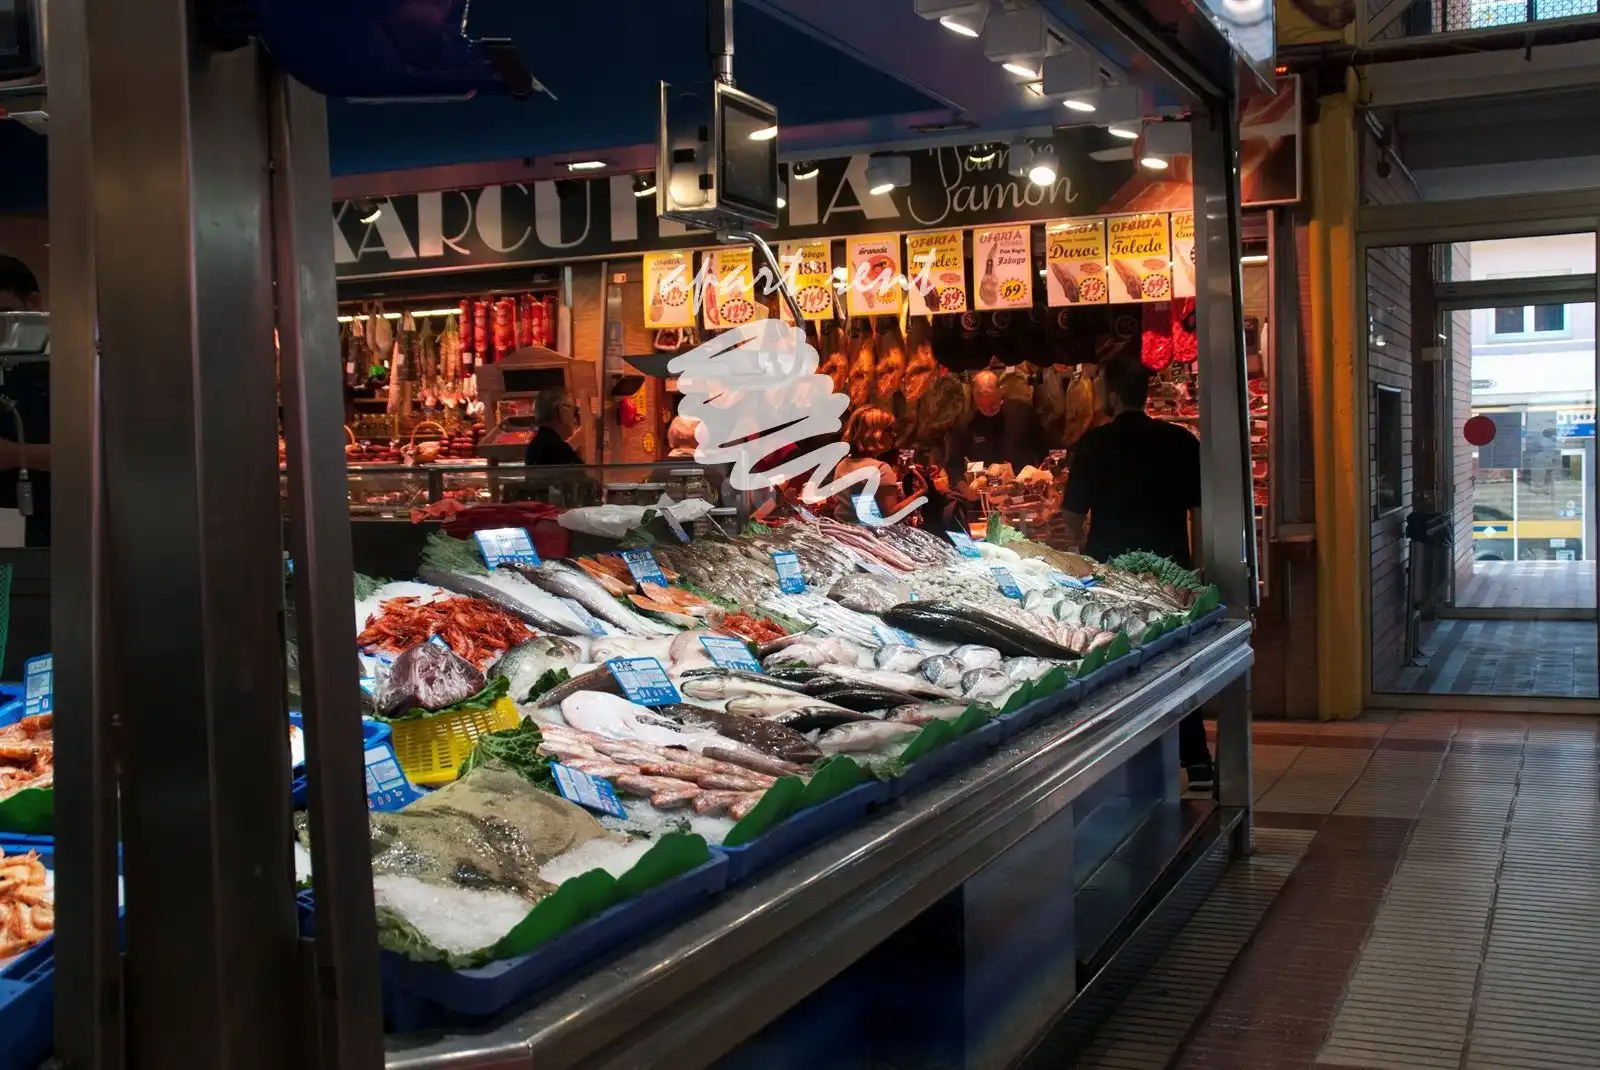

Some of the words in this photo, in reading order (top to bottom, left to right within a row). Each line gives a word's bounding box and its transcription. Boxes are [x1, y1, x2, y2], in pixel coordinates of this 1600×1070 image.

[1111, 218, 1162, 233] OFERTA
[911, 234, 958, 248] OFERTA
[979, 230, 1022, 244] OFERTA
[859, 246, 887, 255] Granada
[1049, 243, 1100, 259] Duroc
[1110, 237, 1163, 255] Toledo
[1084, 281, 1100, 297] 79
[944, 291, 960, 306] 89
[726, 303, 748, 319] 129
